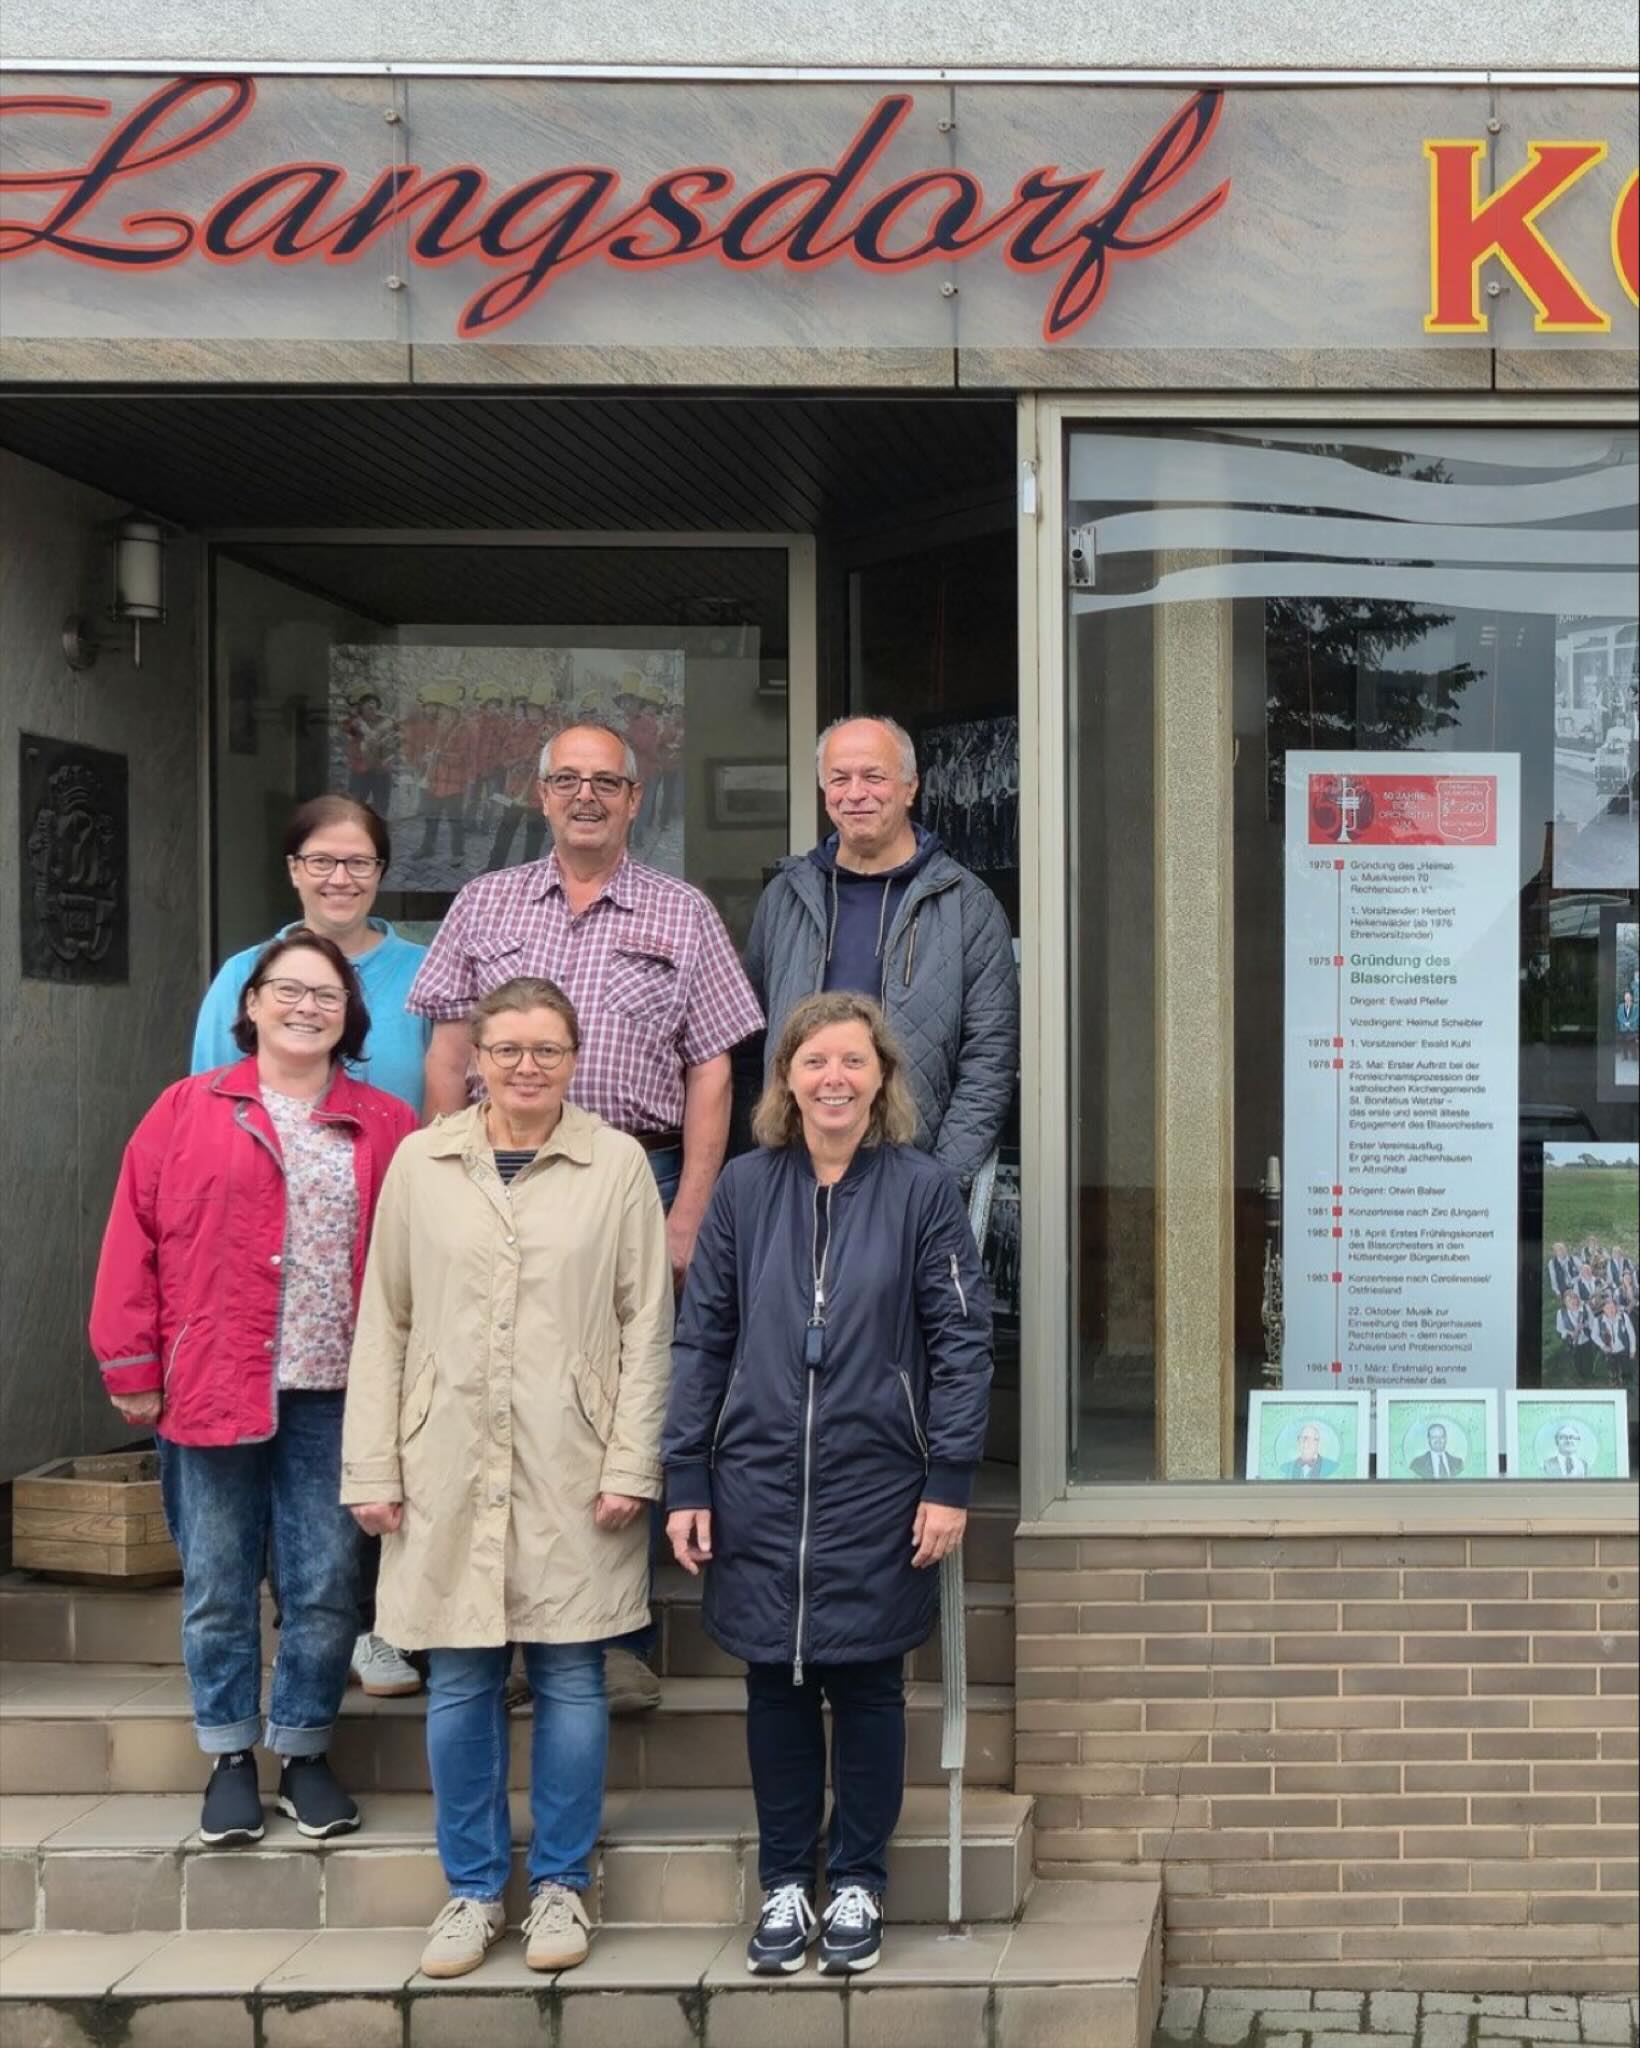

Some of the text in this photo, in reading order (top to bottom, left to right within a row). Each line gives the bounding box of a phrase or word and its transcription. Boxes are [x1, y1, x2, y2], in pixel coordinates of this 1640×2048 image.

[0, 77, 1638, 342] Langsdorf K
[1350, 860, 1396, 871] Gründung
[1398, 860, 1415, 870] des
[1361, 873, 1415, 882] Musikverein
[1361, 906, 1419, 915] Vorsitzender:
[1421, 906, 1456, 915] Herbert
[1350, 954, 1451, 968] Gründung des
[1350, 972, 1457, 984] Blasorchesters
[1389, 996, 1417, 1005] Ewald
[1421, 1039, 1449, 1048] Ewald
[1387, 1060, 1414, 1069] Erster
[1416, 1060, 1447, 1069] Auftritt
[1449, 1060, 1463, 1069] bei
[1465, 1060, 1480, 1069] der
[1465, 1073, 1480, 1081] der
[1349, 1085, 1487, 1095] katholischen Kirchengemeinde
[1411, 1096, 1445, 1105] Wetzlar
[1349, 1108, 1366, 1117] das
[1368, 1108, 1391, 1117] erste
[1393, 1108, 1409, 1117] und
[1412, 1108, 1438, 1117] somit
[1349, 1120, 1494, 1131] Engagement des Blasorchesters
[1349, 1141, 1376, 1150] Erster
[1361, 1154, 1380, 1163] ging
[1383, 1153, 1405, 1162] nach
[1348, 1186, 1386, 1197] Dirigent:
[1348, 1207, 1405, 1216] Konzertreise
[1406, 1207, 1429, 1216] nach
[1389, 1229, 1418, 1238] Erstes
[1420, 1229, 1495, 1240] Frühlingskonzert
[1348, 1241, 1365, 1250] des
[1367, 1241, 1434, 1250] Blasorchesters
[1446, 1241, 1464, 1250] den
[1409, 1252, 1470, 1263] Bürgerstuben
[1348, 1274, 1404, 1283] Konzertreise
[1406, 1274, 1429, 1283] nach
[1347, 1286, 1402, 1295] Ostfriesland
[1406, 1306, 1433, 1316] Musik
[1347, 1318, 1483, 1329] Einweihung des Bürgerhauses
[1416, 1331, 1437, 1340] dem
[1439, 1332, 1467, 1340] neuen
[1347, 1342, 1387, 1352] Zuhause
[1388, 1342, 1406, 1352] und
[1391, 1363, 1433, 1375] Erstmalig
[1435, 1363, 1467, 1373] konnte
[1430, 1376, 1447, 1385] das
